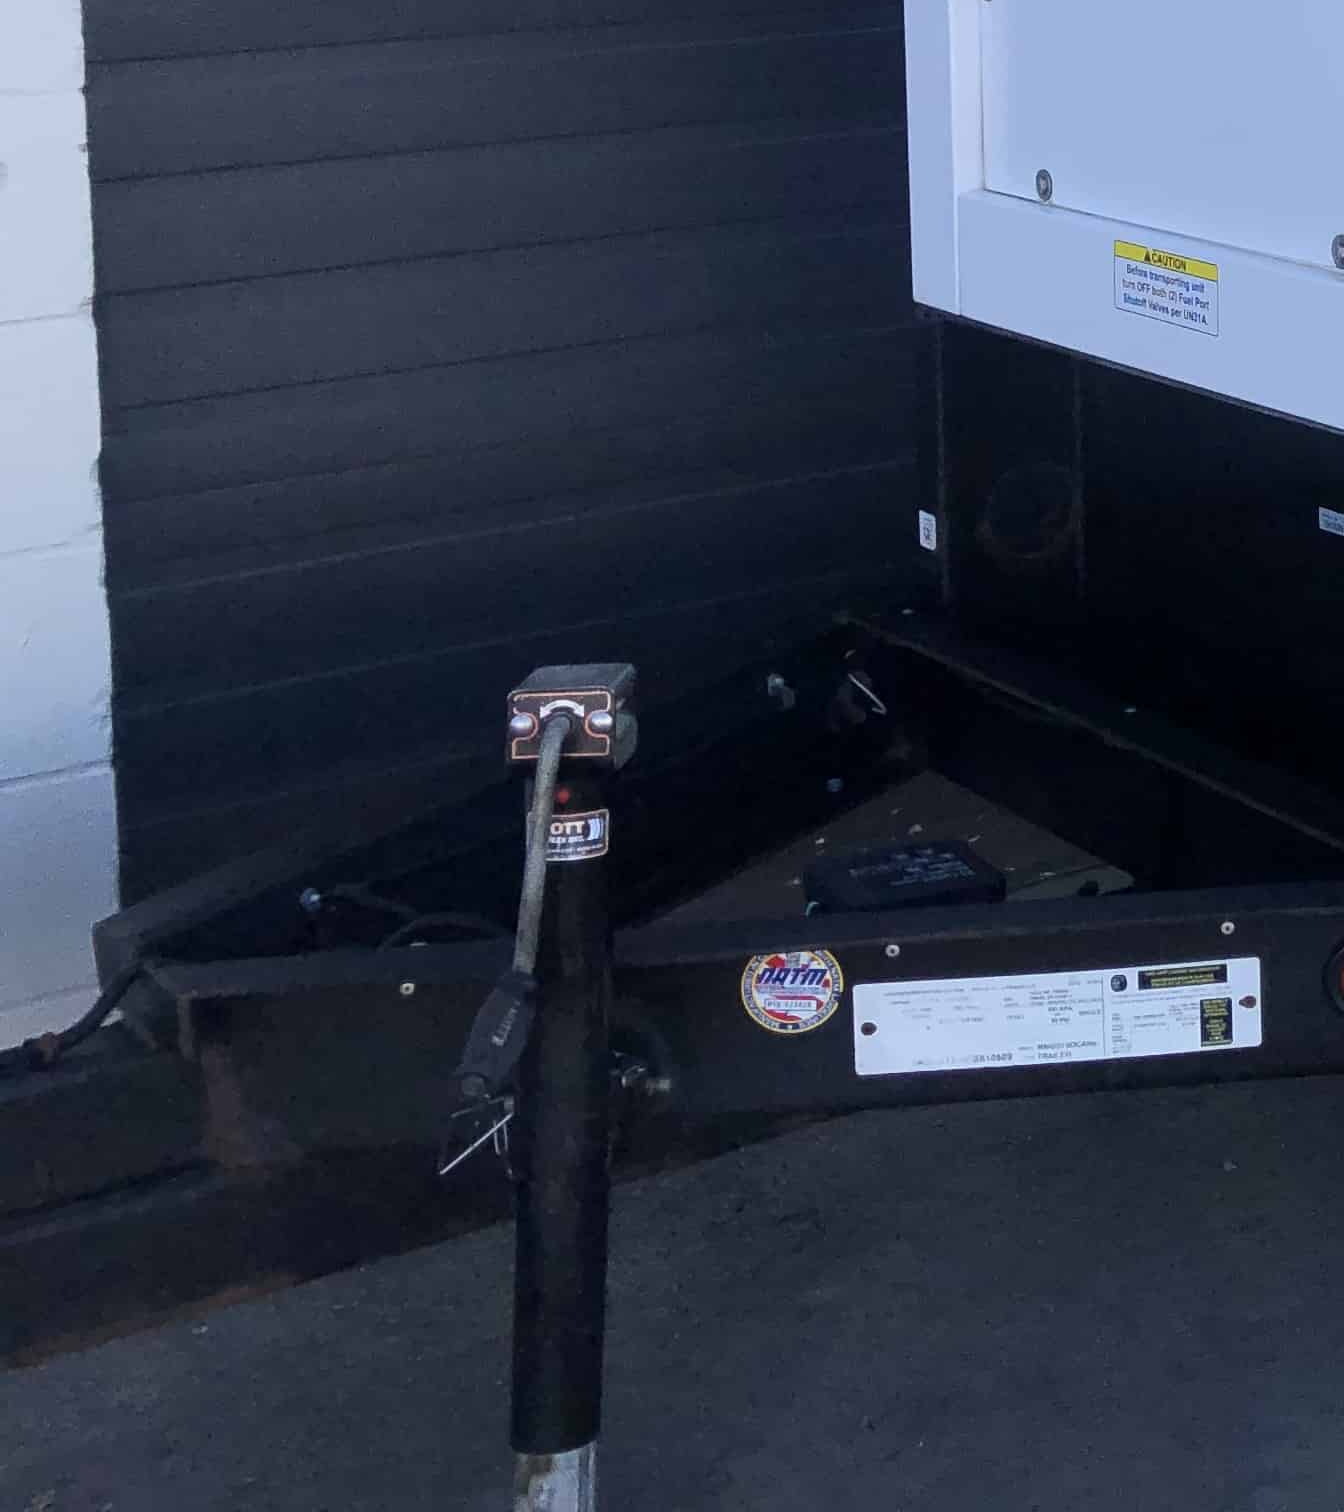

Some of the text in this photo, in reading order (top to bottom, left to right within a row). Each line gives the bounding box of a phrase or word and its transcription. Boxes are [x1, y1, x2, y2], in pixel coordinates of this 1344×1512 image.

[1151, 252, 1187, 272] CAUTION
[1126, 264, 1148, 278] Before
[1149, 271, 1190, 292] transporting
[1136, 281, 1151, 294] OFF
[1168, 290, 1178, 304] (2)
[1178, 292, 1193, 306] Fuel
[1148, 298, 1170, 315] Valves
